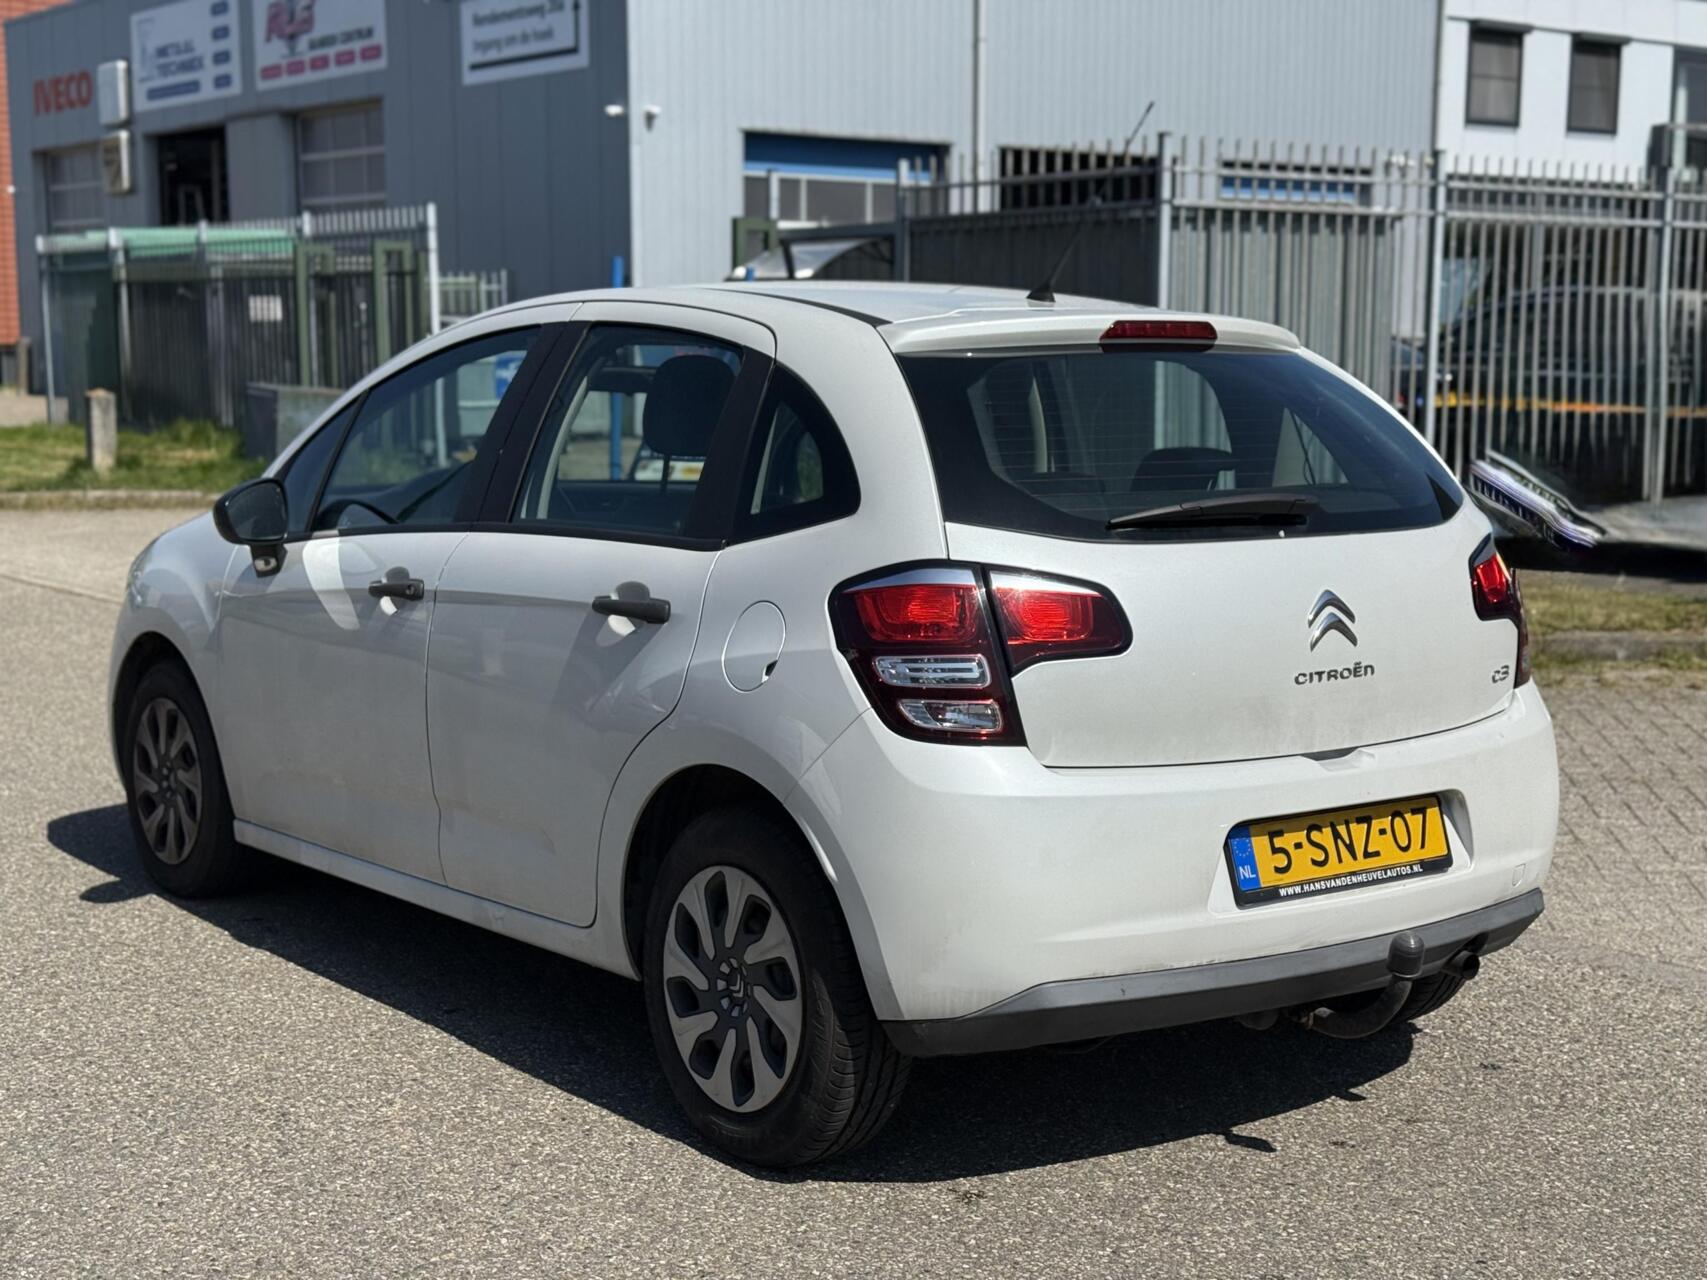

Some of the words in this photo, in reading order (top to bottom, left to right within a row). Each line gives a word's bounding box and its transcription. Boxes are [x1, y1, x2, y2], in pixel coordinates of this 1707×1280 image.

[33, 69, 94, 117] IVECO
[1491, 665, 1510, 684] C3
[1267, 806, 1428, 875] 5-SNZ-07
[1239, 865, 1257, 880] NL
[1279, 866, 1424, 897] WWW.HANSVANDENHEUVELAUTOS.NL
